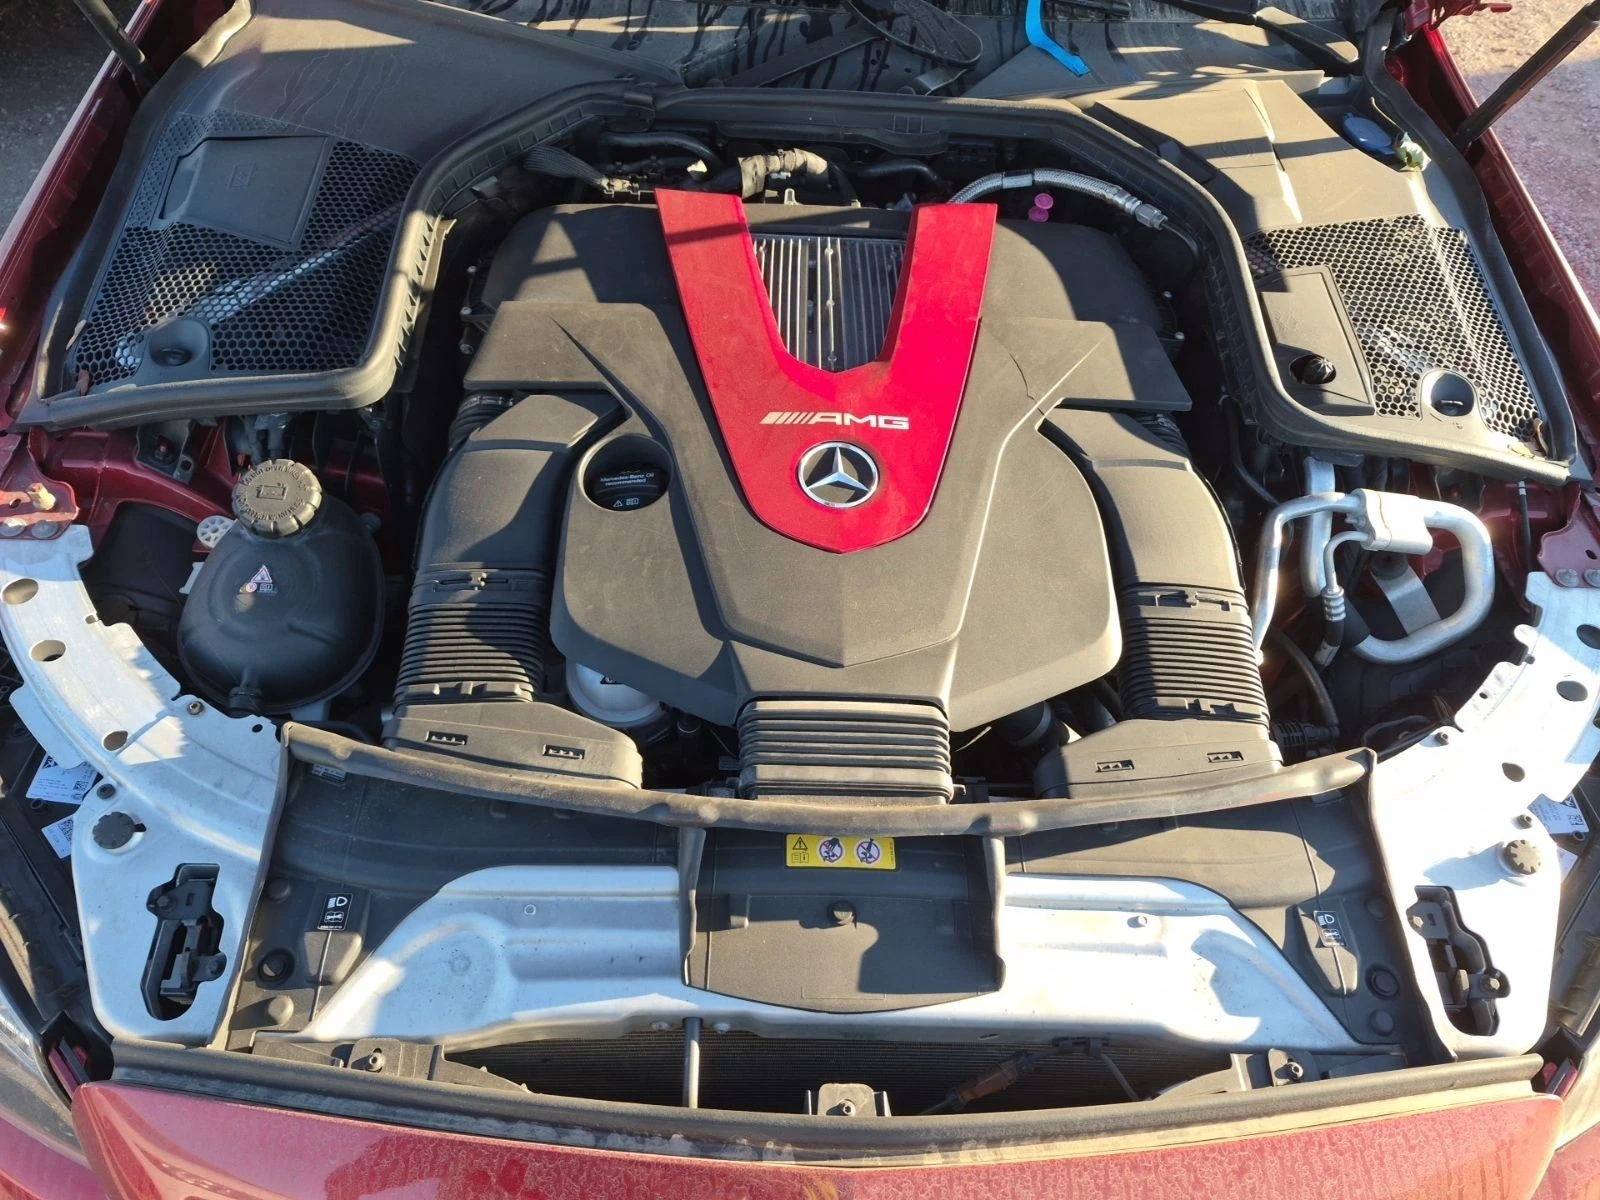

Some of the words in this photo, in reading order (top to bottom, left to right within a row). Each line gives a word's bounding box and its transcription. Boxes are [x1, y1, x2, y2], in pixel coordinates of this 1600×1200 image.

[807, 411, 910, 430] AMG
[600, 474, 645, 482] Mercedes-Benz
[605, 478, 647, 487] recommended
